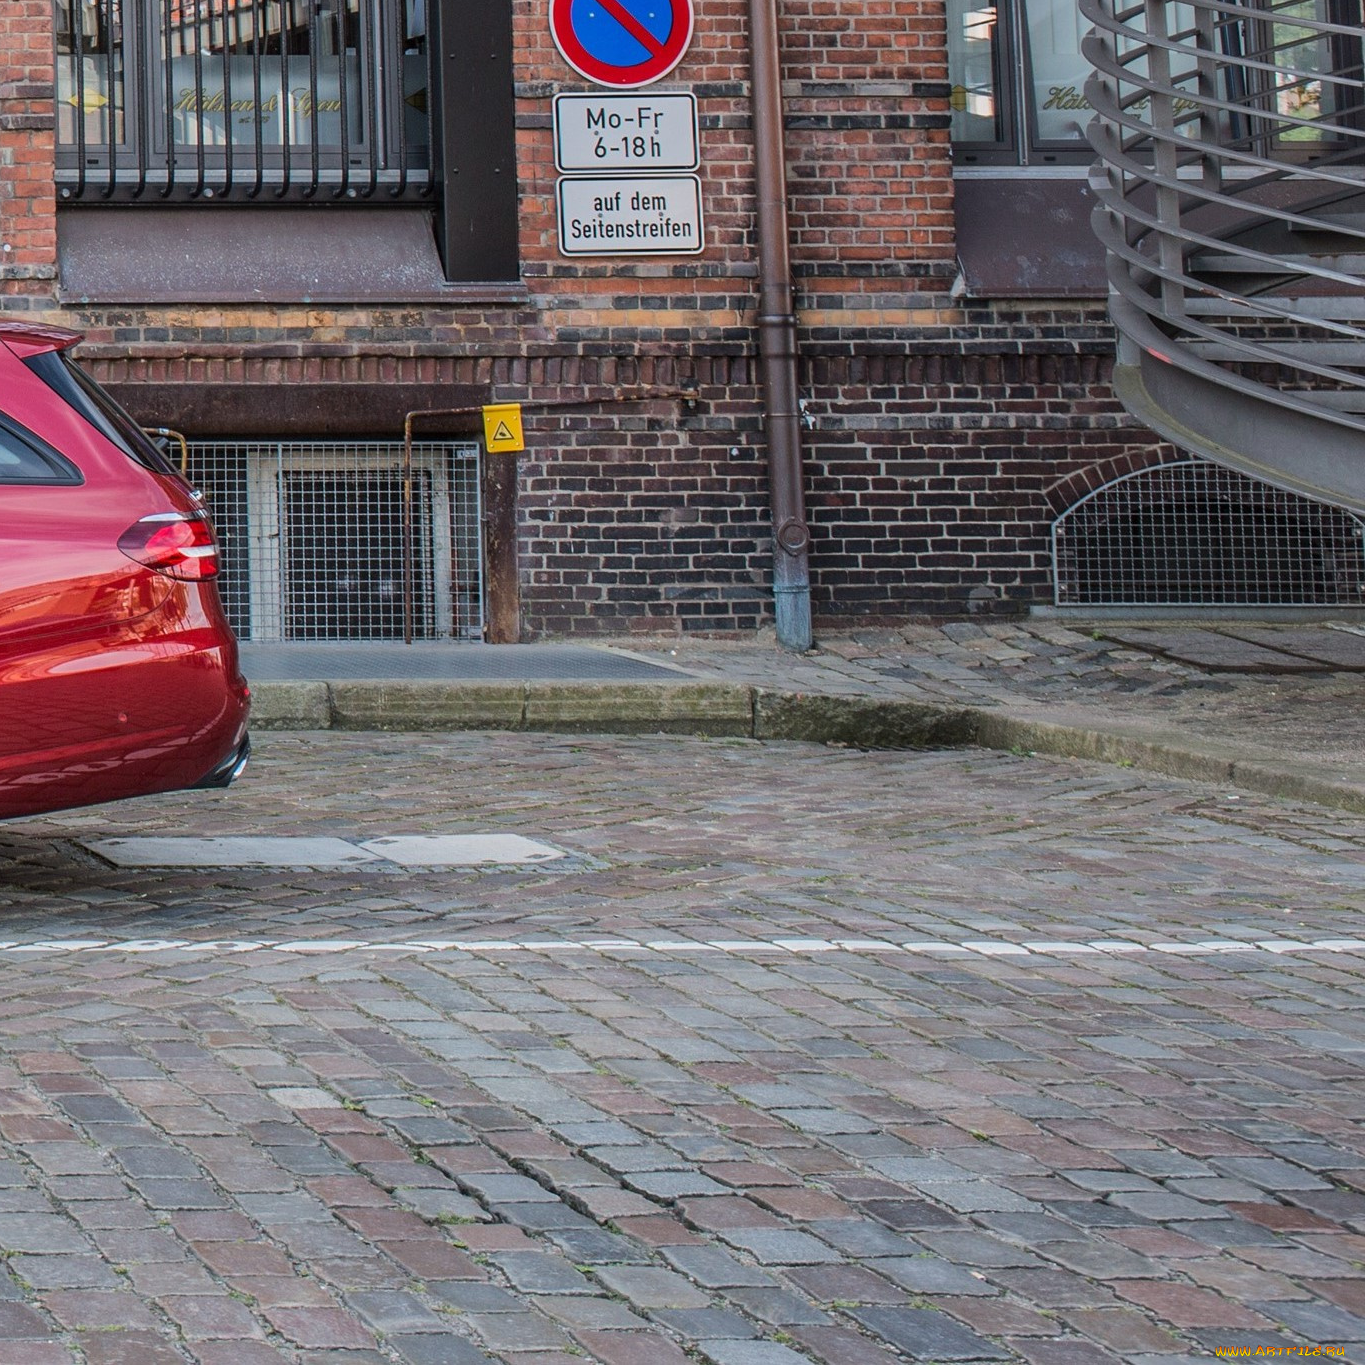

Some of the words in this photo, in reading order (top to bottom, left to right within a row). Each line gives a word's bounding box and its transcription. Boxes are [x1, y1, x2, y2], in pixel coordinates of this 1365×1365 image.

[586, 107, 664, 129] Mo-Fr
[594, 191, 621, 212] auf
[631, 191, 666, 211] dem
[571, 217, 692, 240] Seitenstreifen
